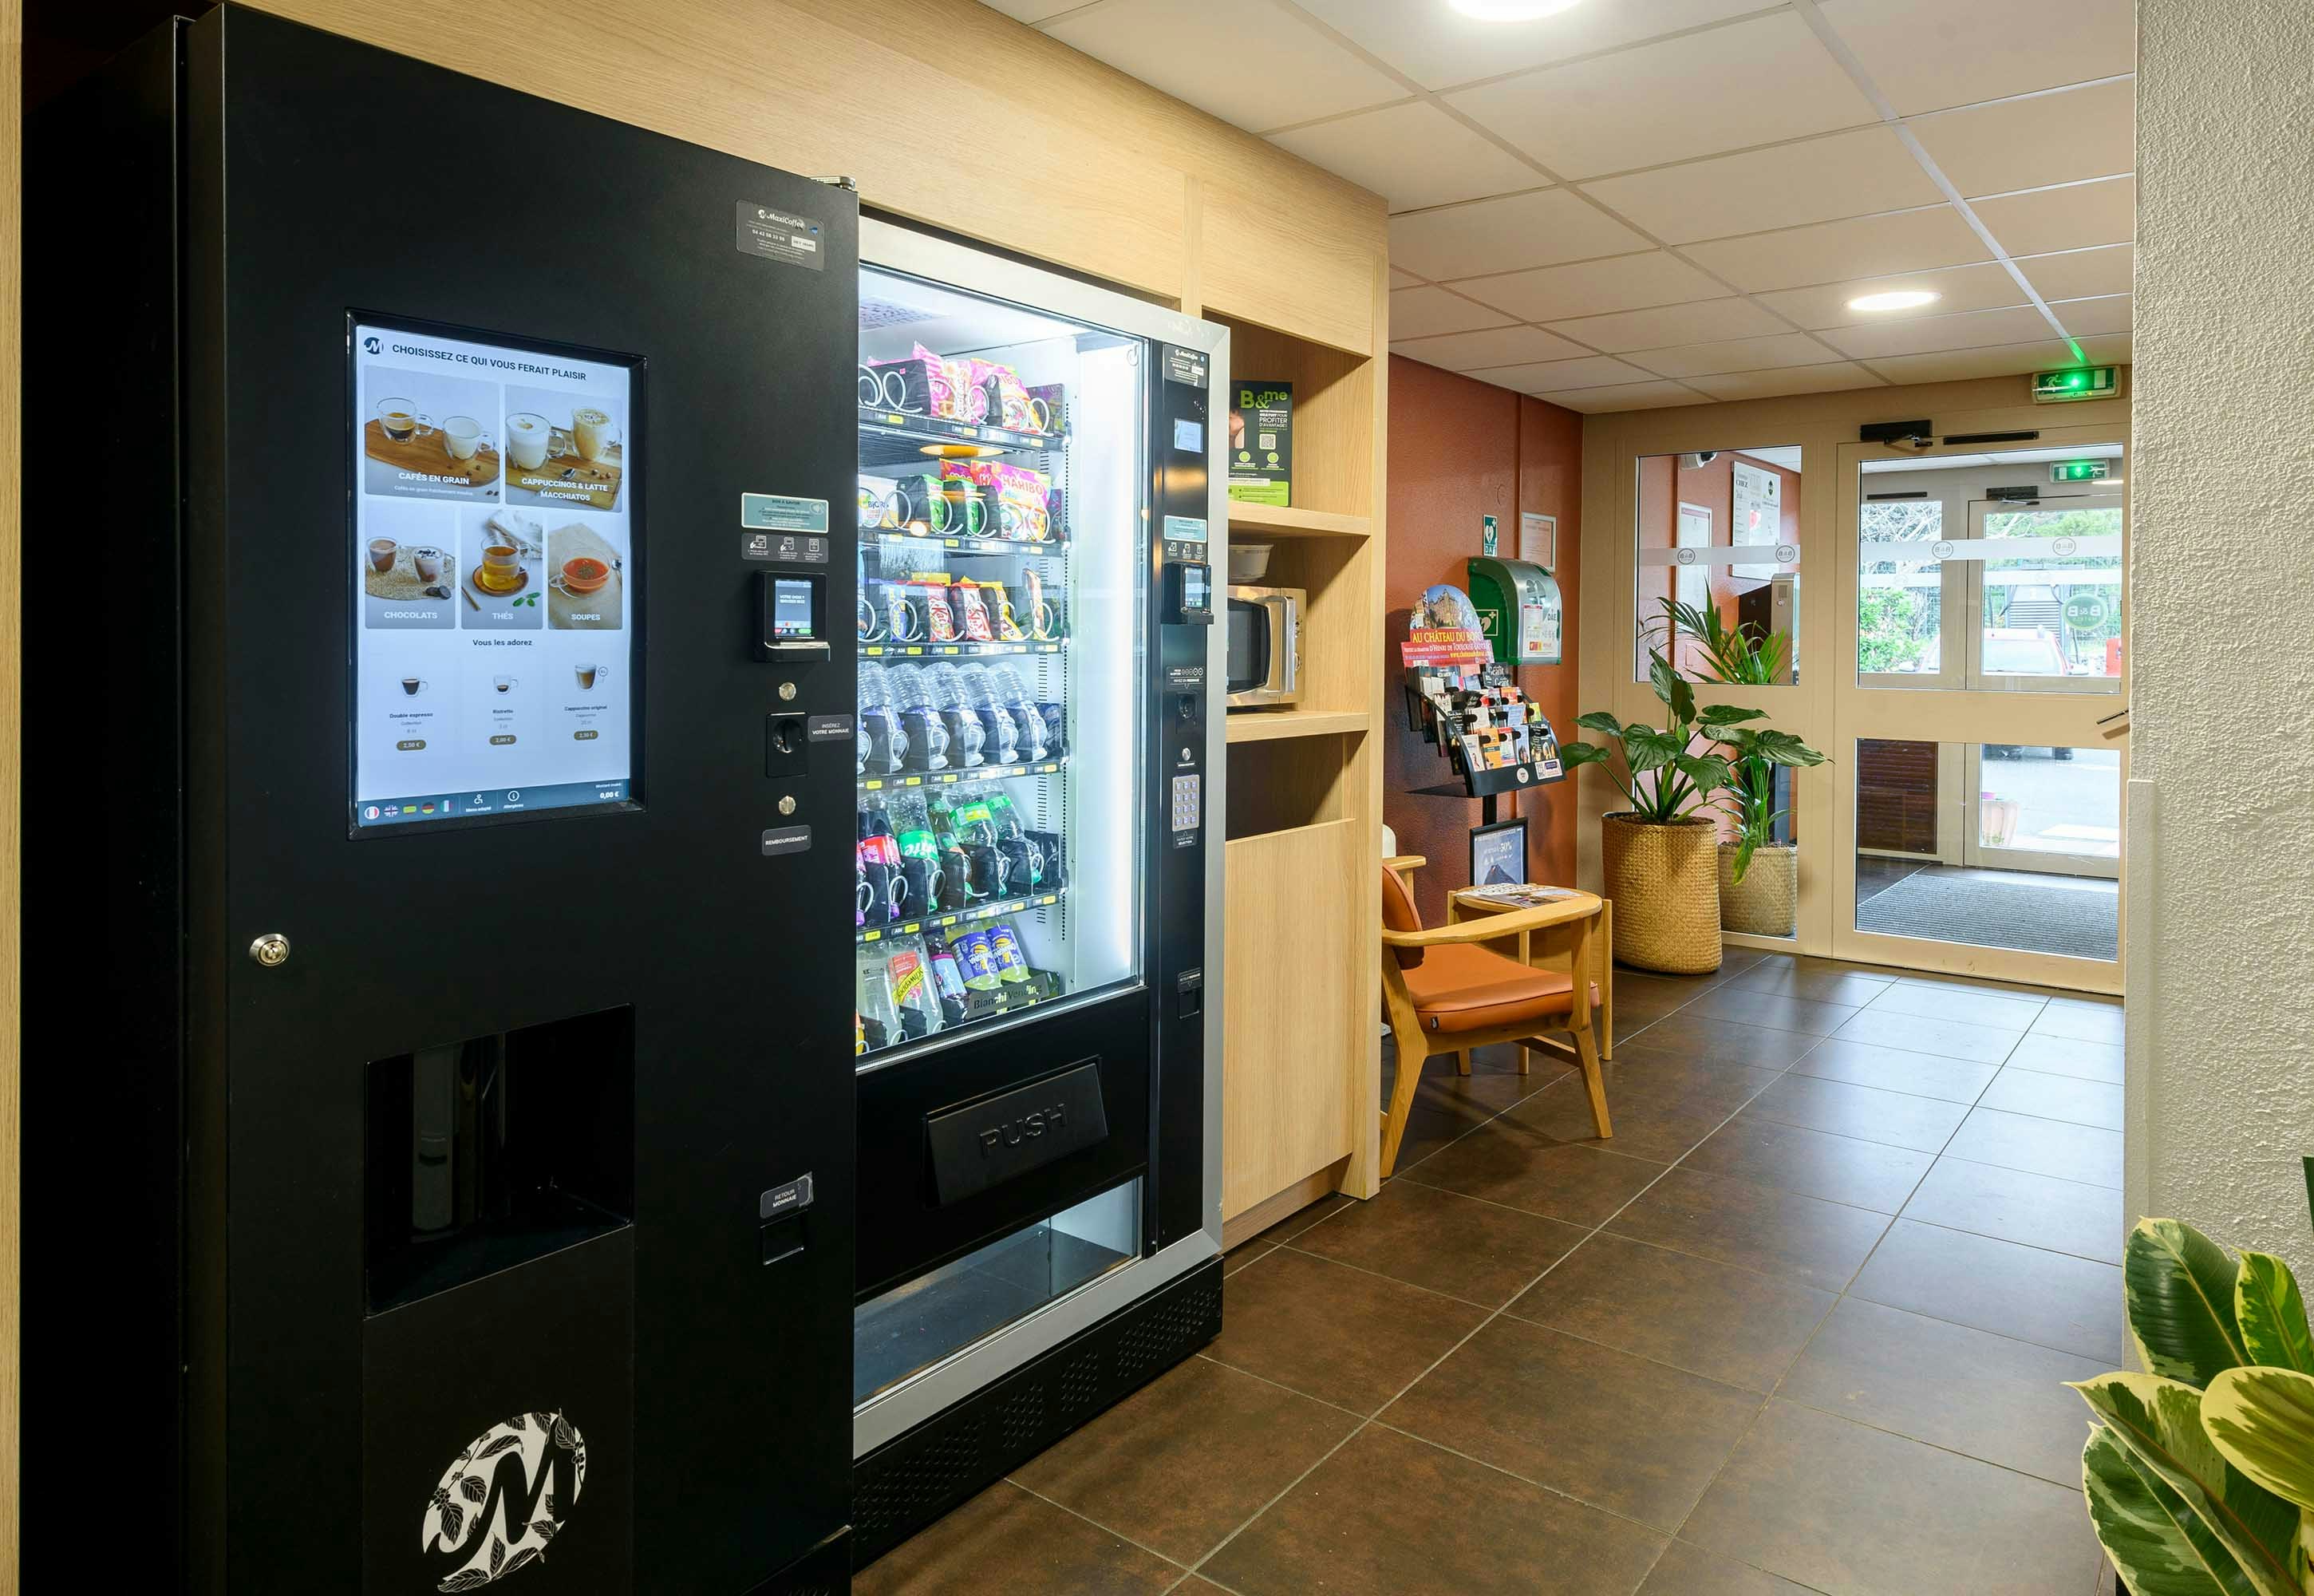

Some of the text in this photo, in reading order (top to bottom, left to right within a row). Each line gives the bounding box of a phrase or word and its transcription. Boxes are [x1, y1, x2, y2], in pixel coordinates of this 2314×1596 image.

[767, 213, 805, 228] MaxiCoffee
[392, 344, 586, 381] CHOISISSEZ CE QUI VOUS FERAIT PLAISIR
[398, 472, 427, 481] CAFÉS
[442, 476, 470, 485] GRAIN
[521, 478, 576, 488] CAPPUCCINOS
[1002, 474, 1043, 495] HARIBO
[540, 491, 590, 501] MACCHIATOS
[384, 610, 438, 620] CHOCOLATS
[492, 611, 513, 620] THÉS
[1412, 633, 1423, 643] AU
[1424, 630, 1455, 643] CHÂTEAU
[1455, 631, 1466, 642] DU
[765, 836, 808, 846] REMBOURSEMENT
[980, 1103, 1068, 1156] PUSH
